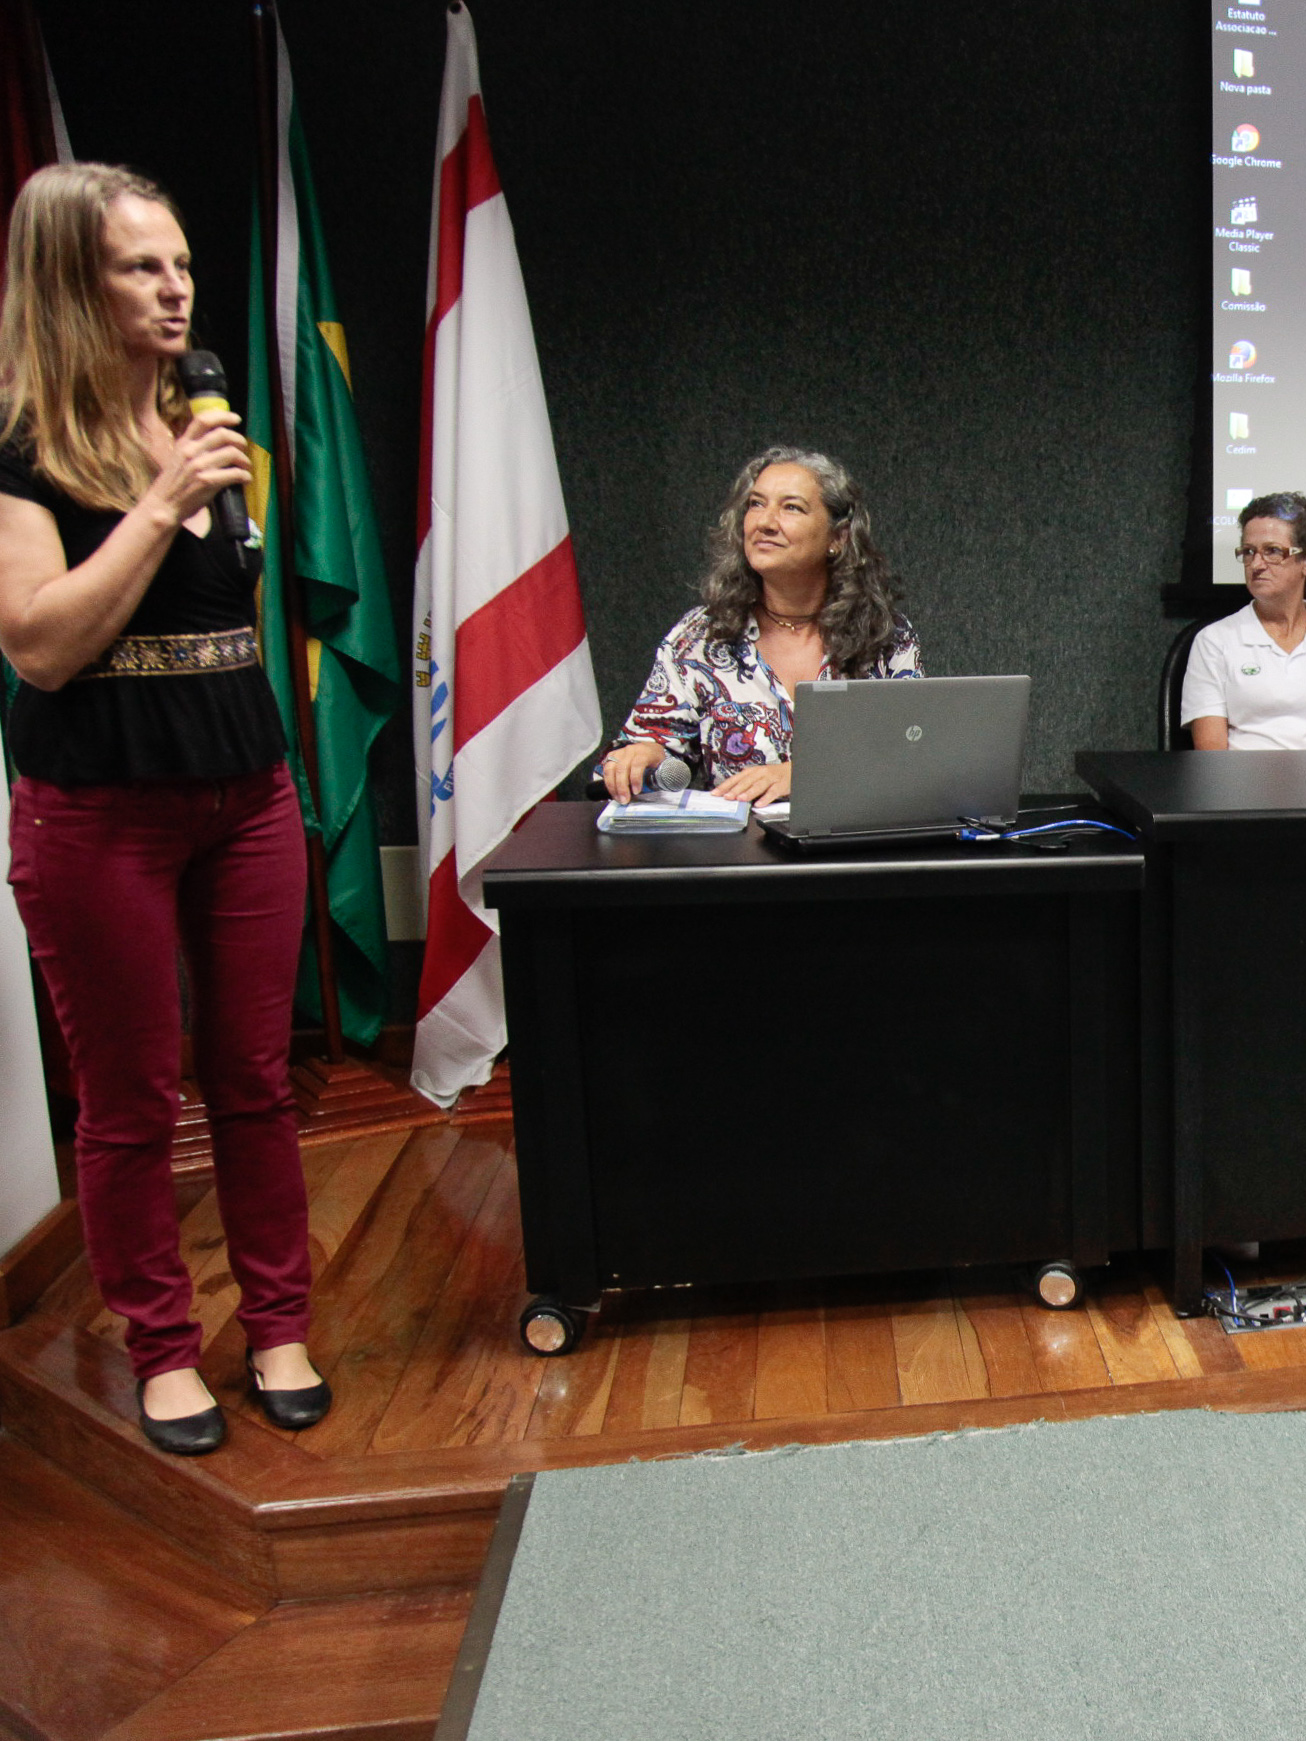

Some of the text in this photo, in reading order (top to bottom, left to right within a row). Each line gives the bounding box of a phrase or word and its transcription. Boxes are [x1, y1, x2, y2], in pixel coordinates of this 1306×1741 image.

[1228, 8, 1266, 21] Estatuto
[1216, 21, 1267, 35] Associacao
[1220, 81, 1272, 96] Nova pasta
[1244, 156, 1282, 168] Chrome
[1215, 227, 1274, 242] Media Player
[1229, 241, 1260, 253] Classic
[1221, 300, 1266, 312] Comissão
[1245, 373, 1276, 384] Firefox
[906, 725, 922, 742] hp
